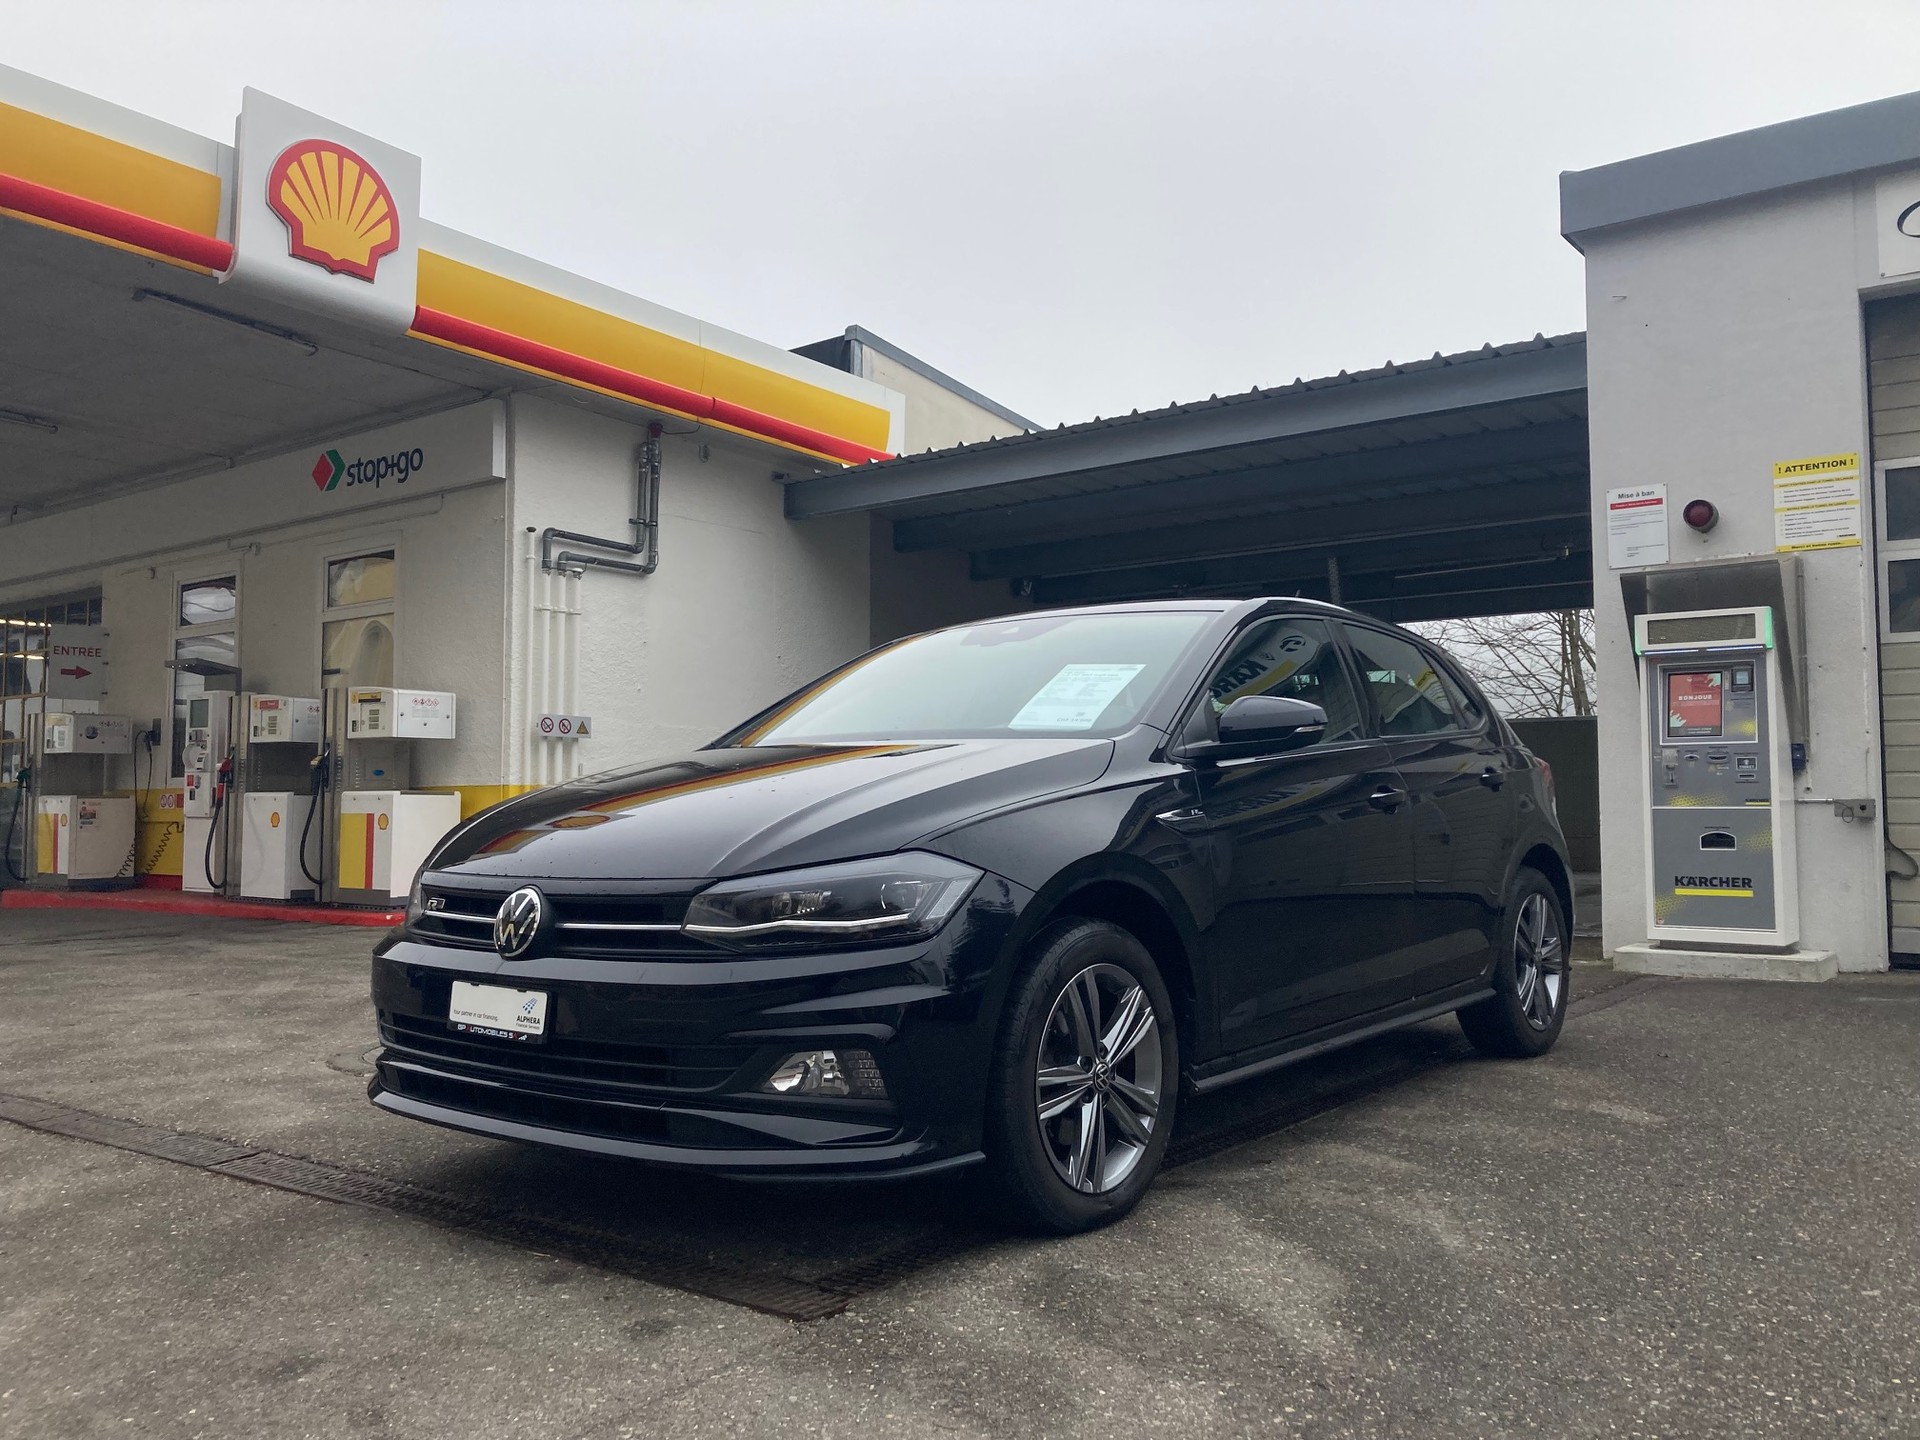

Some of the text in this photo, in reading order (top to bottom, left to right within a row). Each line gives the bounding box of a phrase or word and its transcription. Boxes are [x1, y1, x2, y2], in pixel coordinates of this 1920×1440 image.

[346, 448, 424, 488] stop+go
[1784, 459, 1847, 473] ATTENTION
[1674, 875, 1753, 888] KÄRCHER
[516, 1015, 541, 1025] ALPHERA
